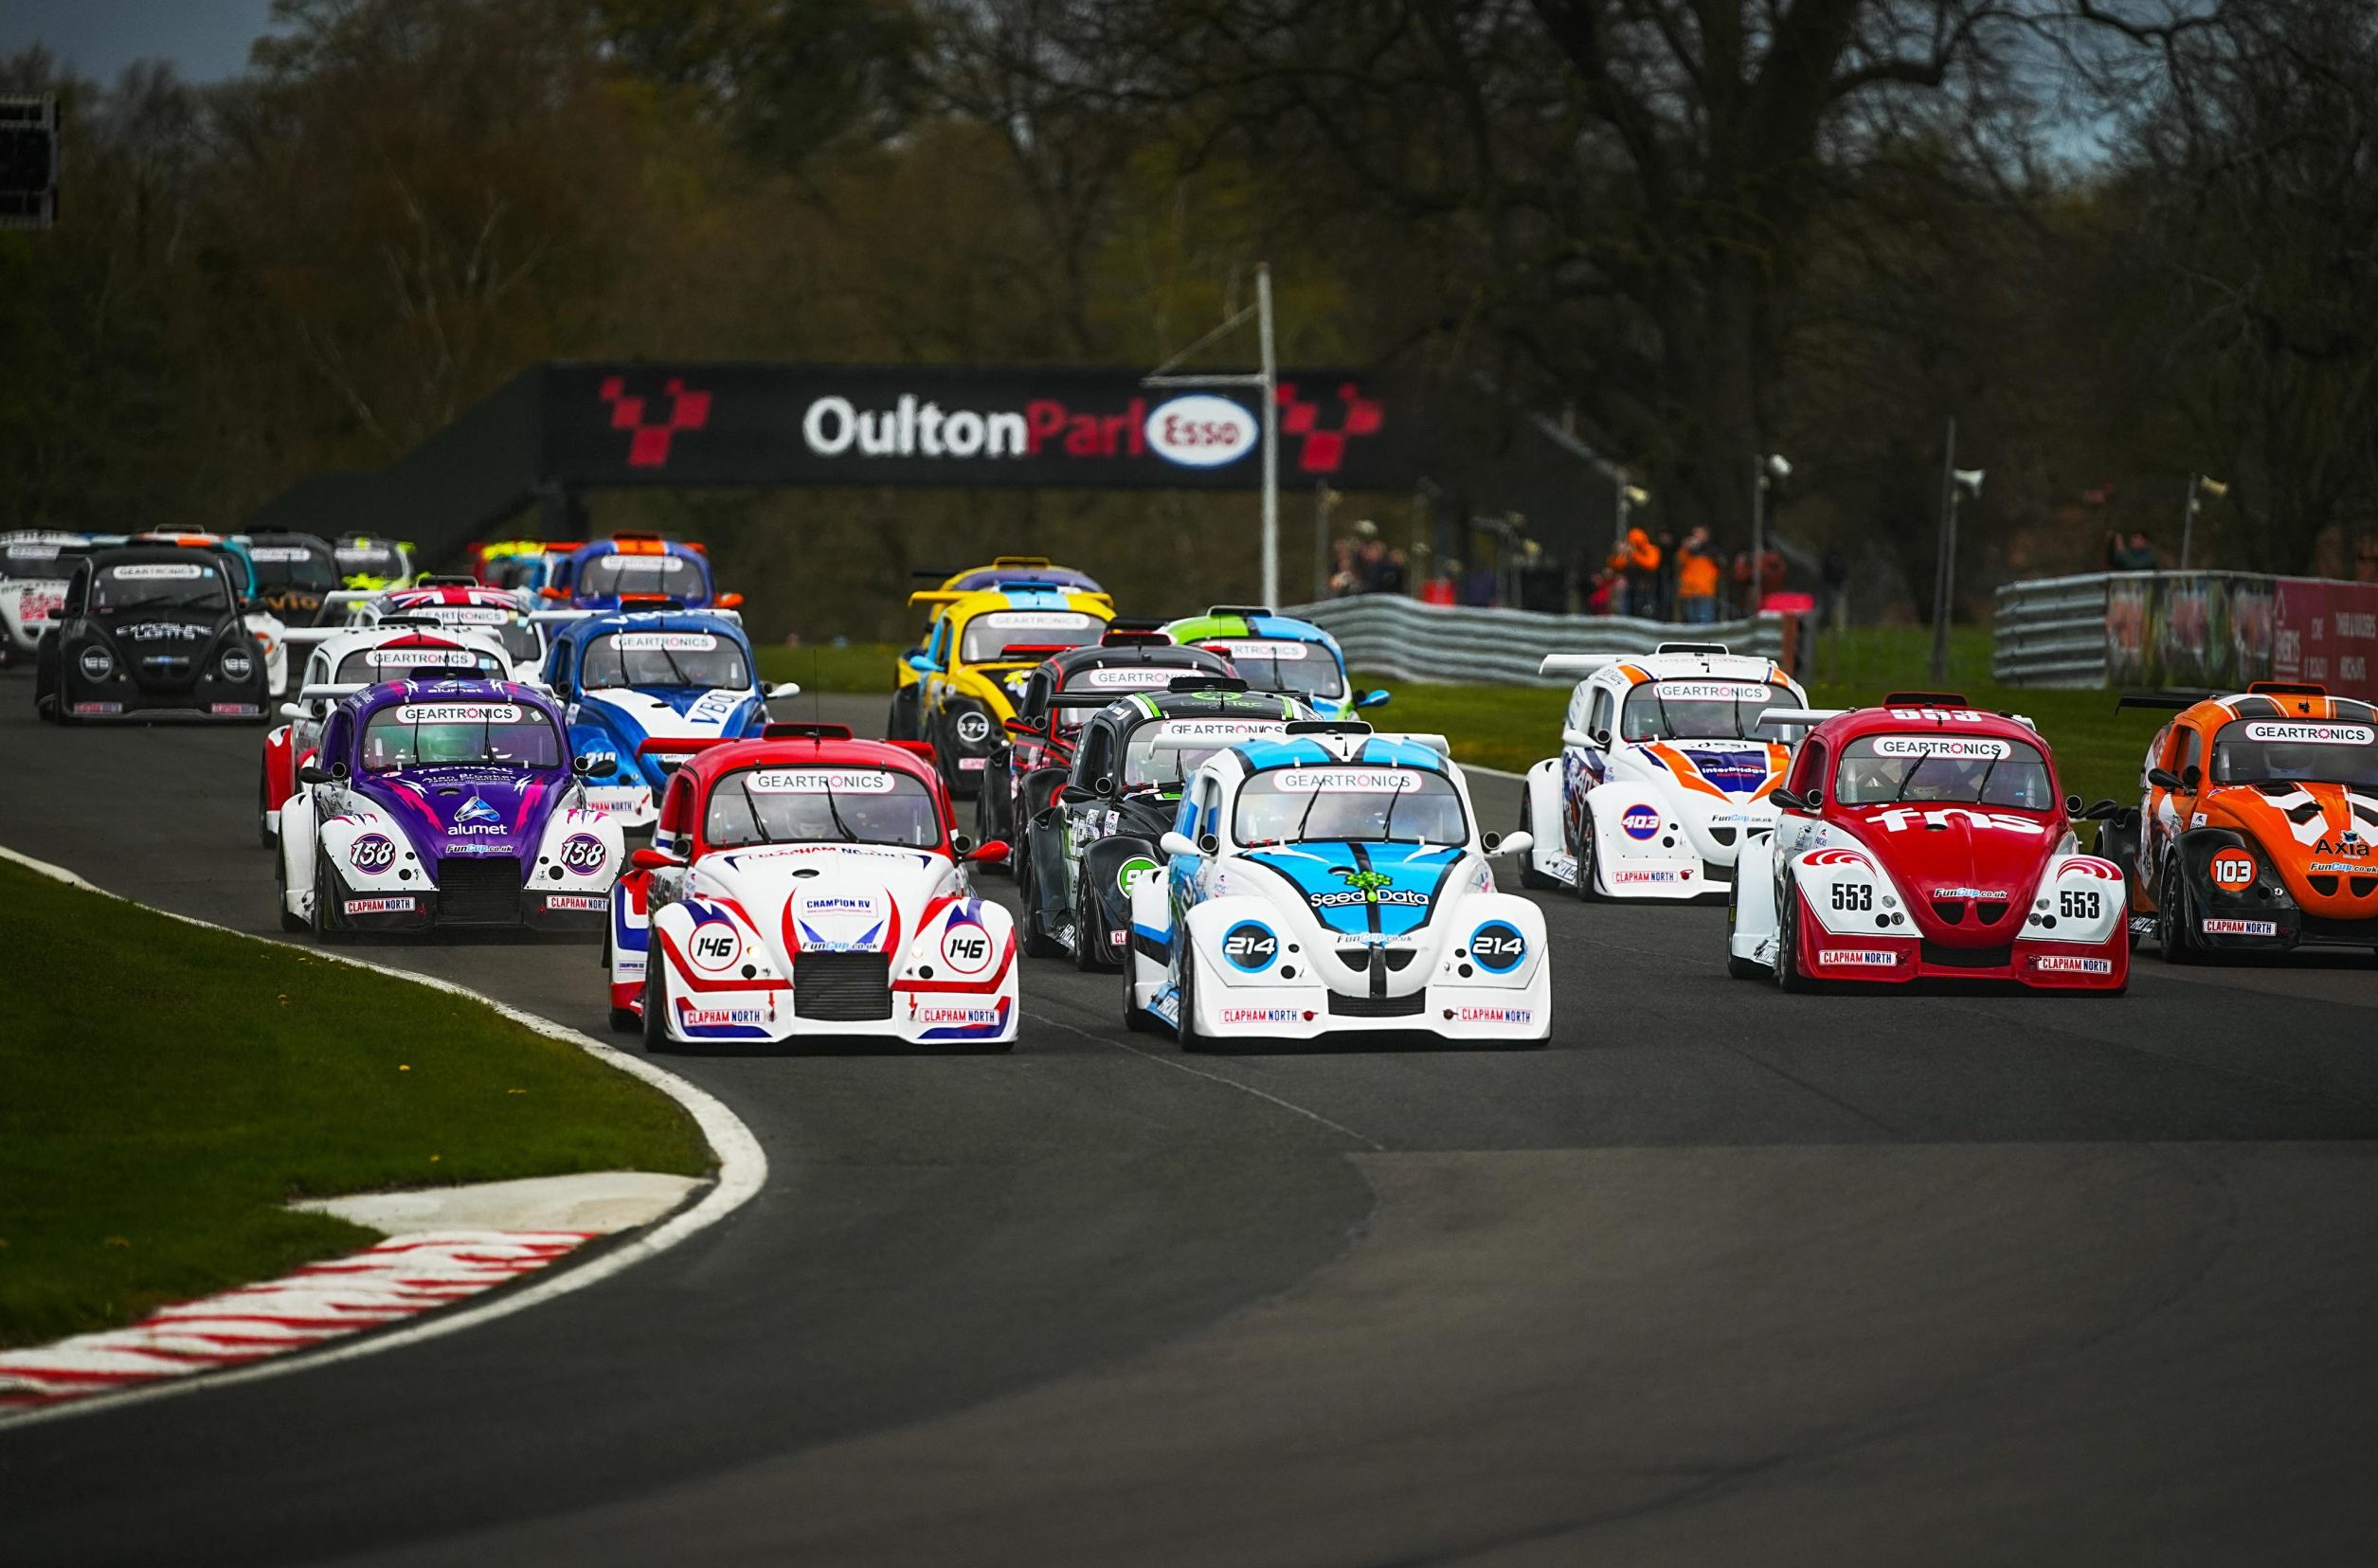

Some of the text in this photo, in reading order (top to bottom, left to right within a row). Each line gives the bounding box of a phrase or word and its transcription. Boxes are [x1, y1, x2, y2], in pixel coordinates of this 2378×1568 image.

[1164, 413, 1239, 445] Esso
[619, 638, 709, 648] GEARTRONICS
[374, 653, 468, 664] GEARTRONICS
[1662, 686, 1762, 698] GEARTRONICS
[405, 708, 513, 719] GEARTRONICS
[1890, 709, 1983, 722] 553
[2255, 726, 2366, 741] GEARTRONICS
[1883, 741, 2001, 755] GEARTRONICS
[758, 775, 884, 788] GEARTRONICS
[1285, 774, 1411, 787] GEARTRONICS
[611, 802, 632, 812] NORTH
[1621, 815, 1660, 829] 403
[1865, 807, 2045, 834] fns
[447, 822, 508, 836] alumet
[350, 840, 394, 867] 158
[446, 843, 513, 854] FunCup.co.uk
[560, 840, 605, 868] 158
[2314, 838, 2370, 856] Axia
[2215, 859, 2252, 883] 103
[2310, 862, 2378, 874] FunCup.co.uk
[1615, 871, 1675, 882] CLAPHAM NORTH
[1310, 889, 1430, 908] Seed Data
[1832, 883, 1873, 911] 553
[1935, 888, 2008, 899] FunCup.co.uk
[348, 899, 410, 912] CLAPHAM NORTH
[551, 897, 607, 910] CLAPHAM NORT
[806, 898, 871, 909] CHAMPION RV
[2060, 890, 2100, 919] 553
[2207, 920, 2272, 934] CLAPHAM NORTH
[696, 937, 734, 957] 146
[802, 941, 878, 951] FunCup.co.uk
[949, 939, 986, 959] 146
[1224, 936, 1276, 955] 214
[1471, 936, 1523, 956] 214
[1824, 952, 1892, 964] CLAPHAM NORTH
[2042, 957, 2108, 973] CLAPHAM NORTH
[688, 1010, 760, 1024] CLAPHAM NORTH
[924, 1009, 995, 1023] CLAPHAM NORTH
[1225, 1010, 1297, 1022] CLAPHAM NORTH
[1462, 1009, 1531, 1023] CLAPHAM NORTH
